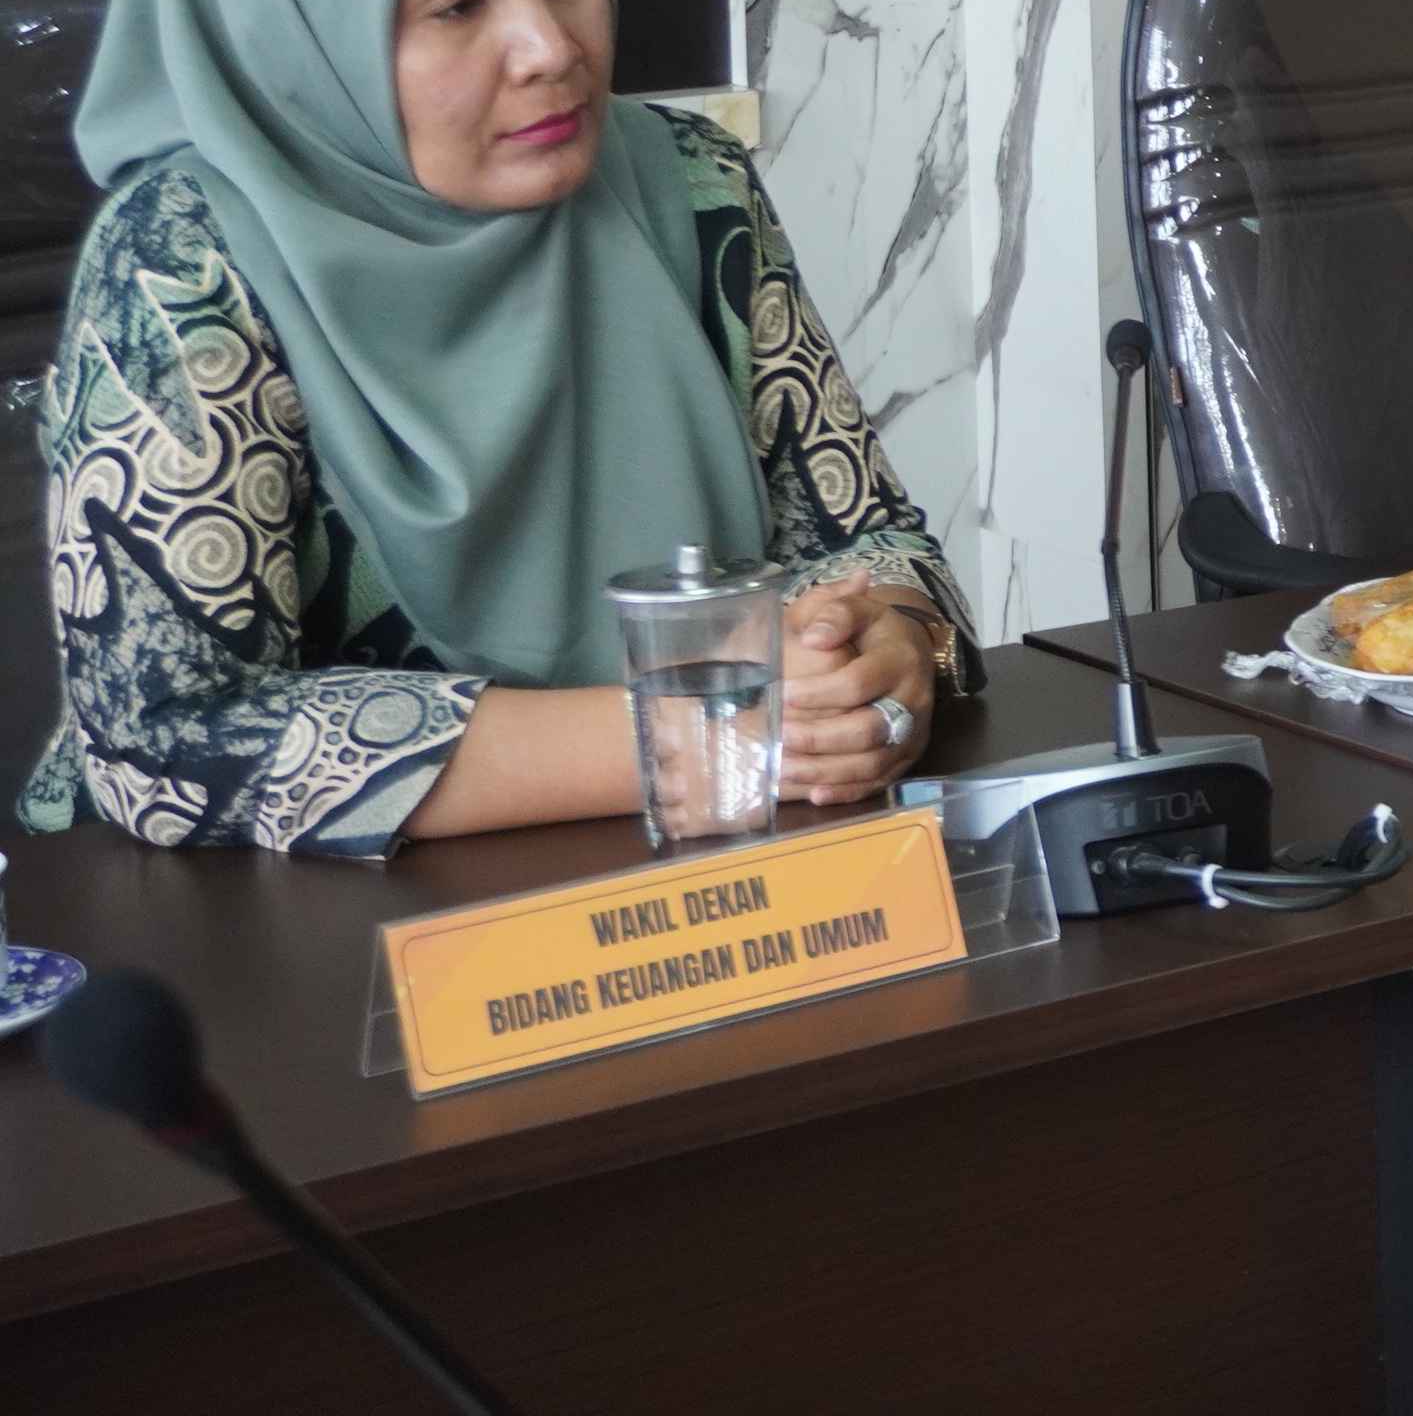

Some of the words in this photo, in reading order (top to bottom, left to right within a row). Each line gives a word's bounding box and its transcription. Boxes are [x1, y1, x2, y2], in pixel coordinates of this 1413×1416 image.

[1146, 791, 1214, 823] TOA
[590, 896, 677, 947] WAKIL
[684, 875, 770, 925] DEKAN
[486, 979, 592, 1037] BIDANG
[597, 942, 737, 1009] KEUANGAN
[744, 927, 797, 973] DAN
[804, 907, 889, 961] UMUM
